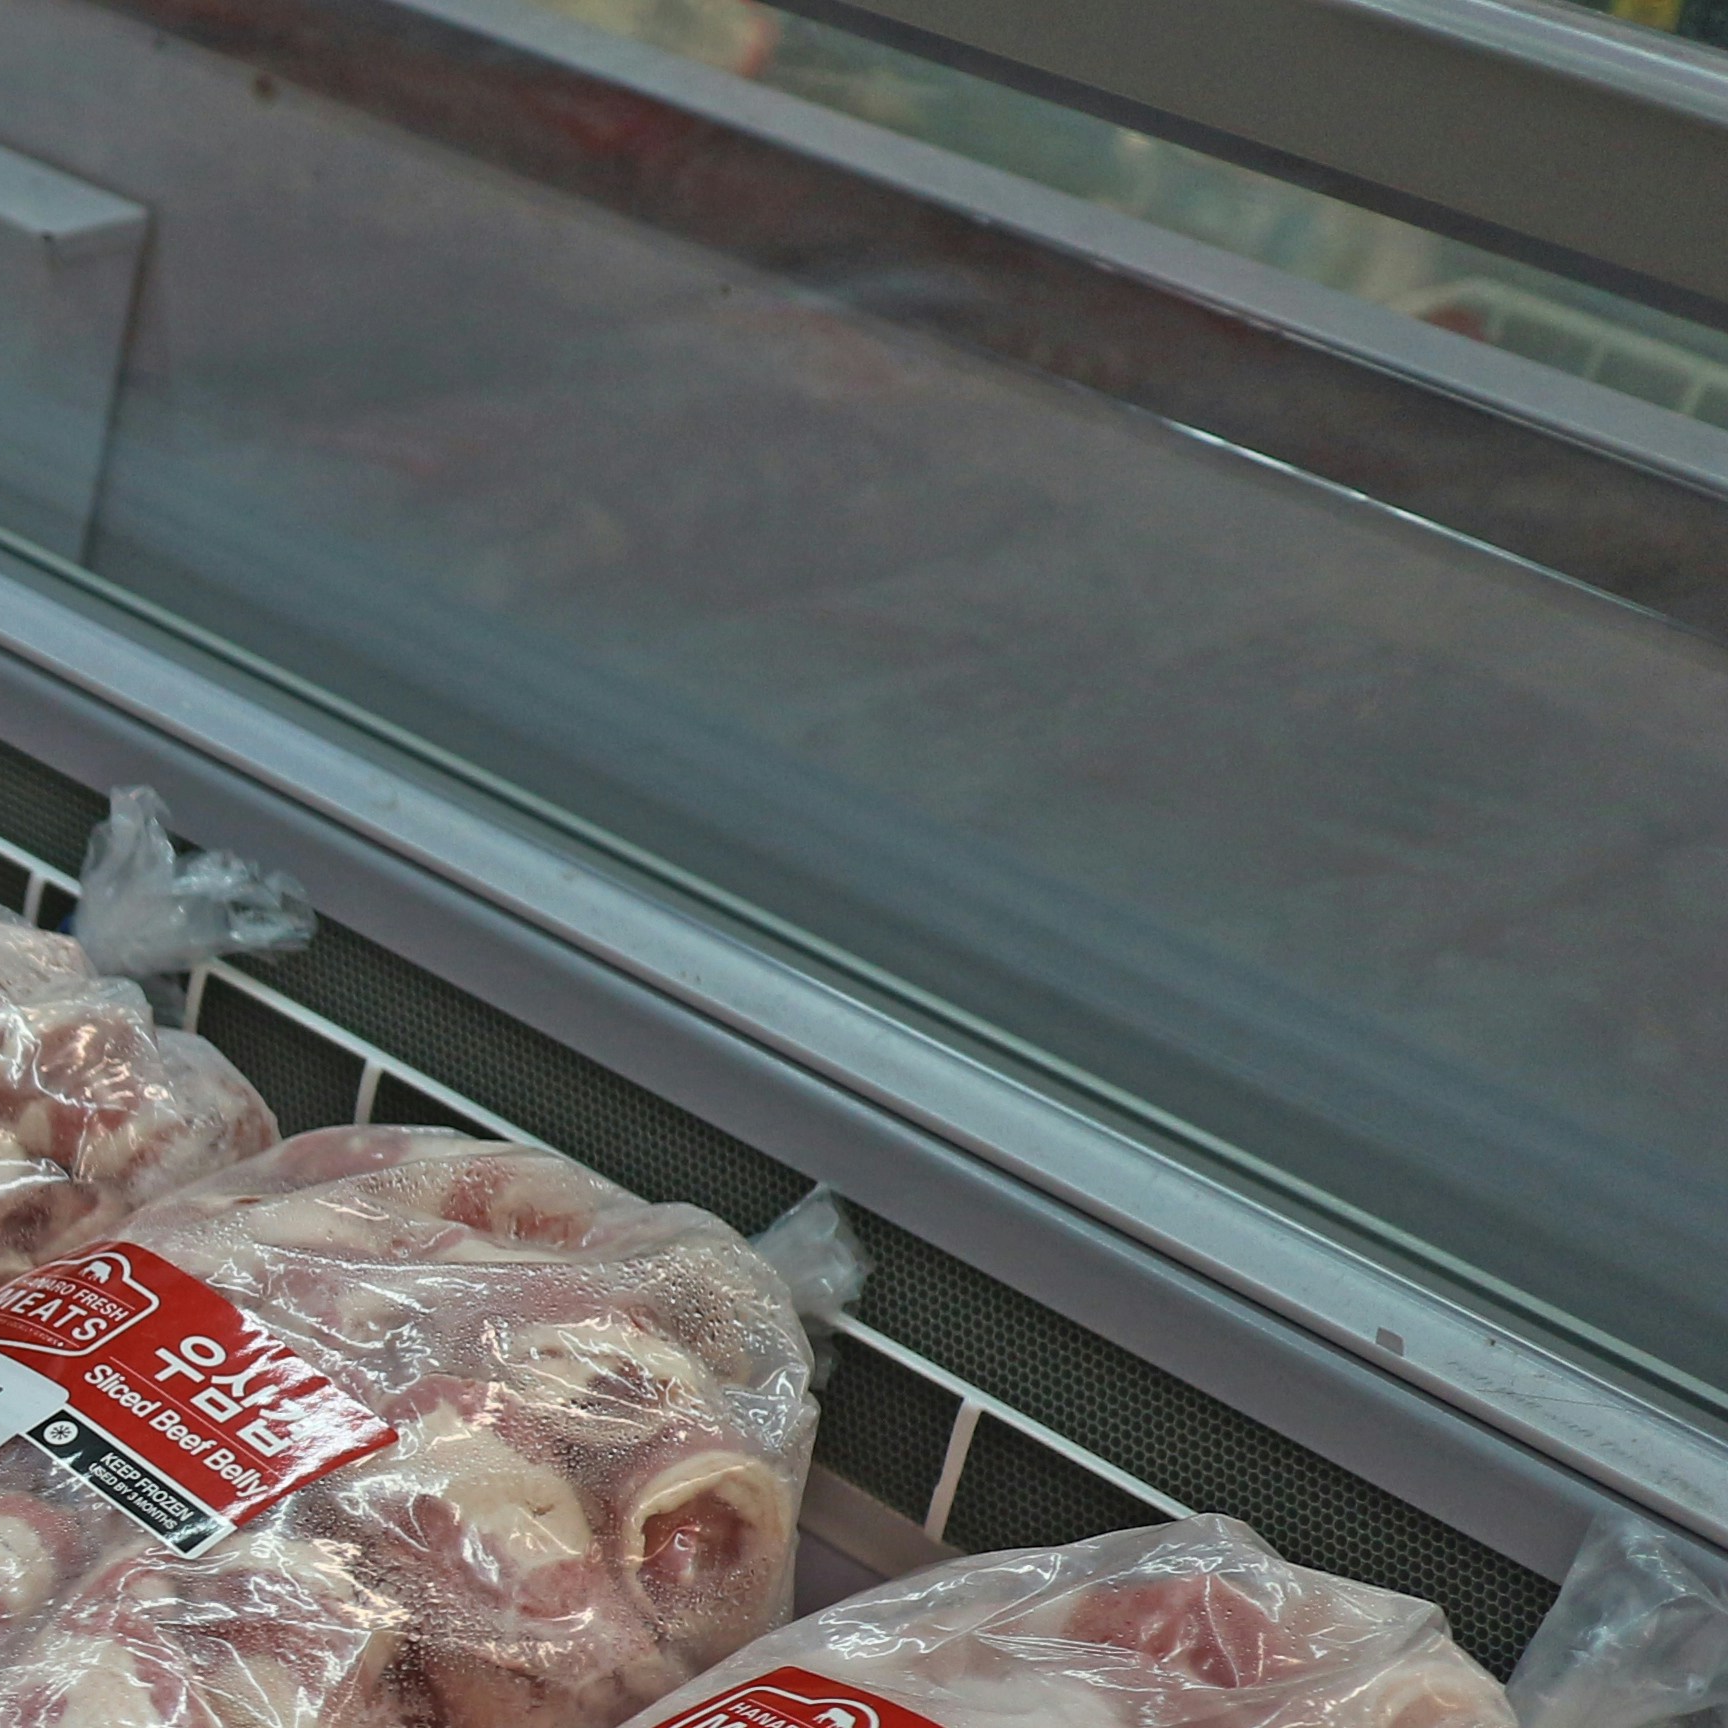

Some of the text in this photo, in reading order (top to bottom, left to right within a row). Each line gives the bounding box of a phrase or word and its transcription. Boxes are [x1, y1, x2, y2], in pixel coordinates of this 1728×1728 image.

[72, 1288, 130, 1322] FRESH
[84, 1364, 271, 1498] Sliced Beef Belly
[88, 1462, 179, 1532] USED BY 3 MONTHS
[100, 1451, 194, 1522] KEEP FROZEN
